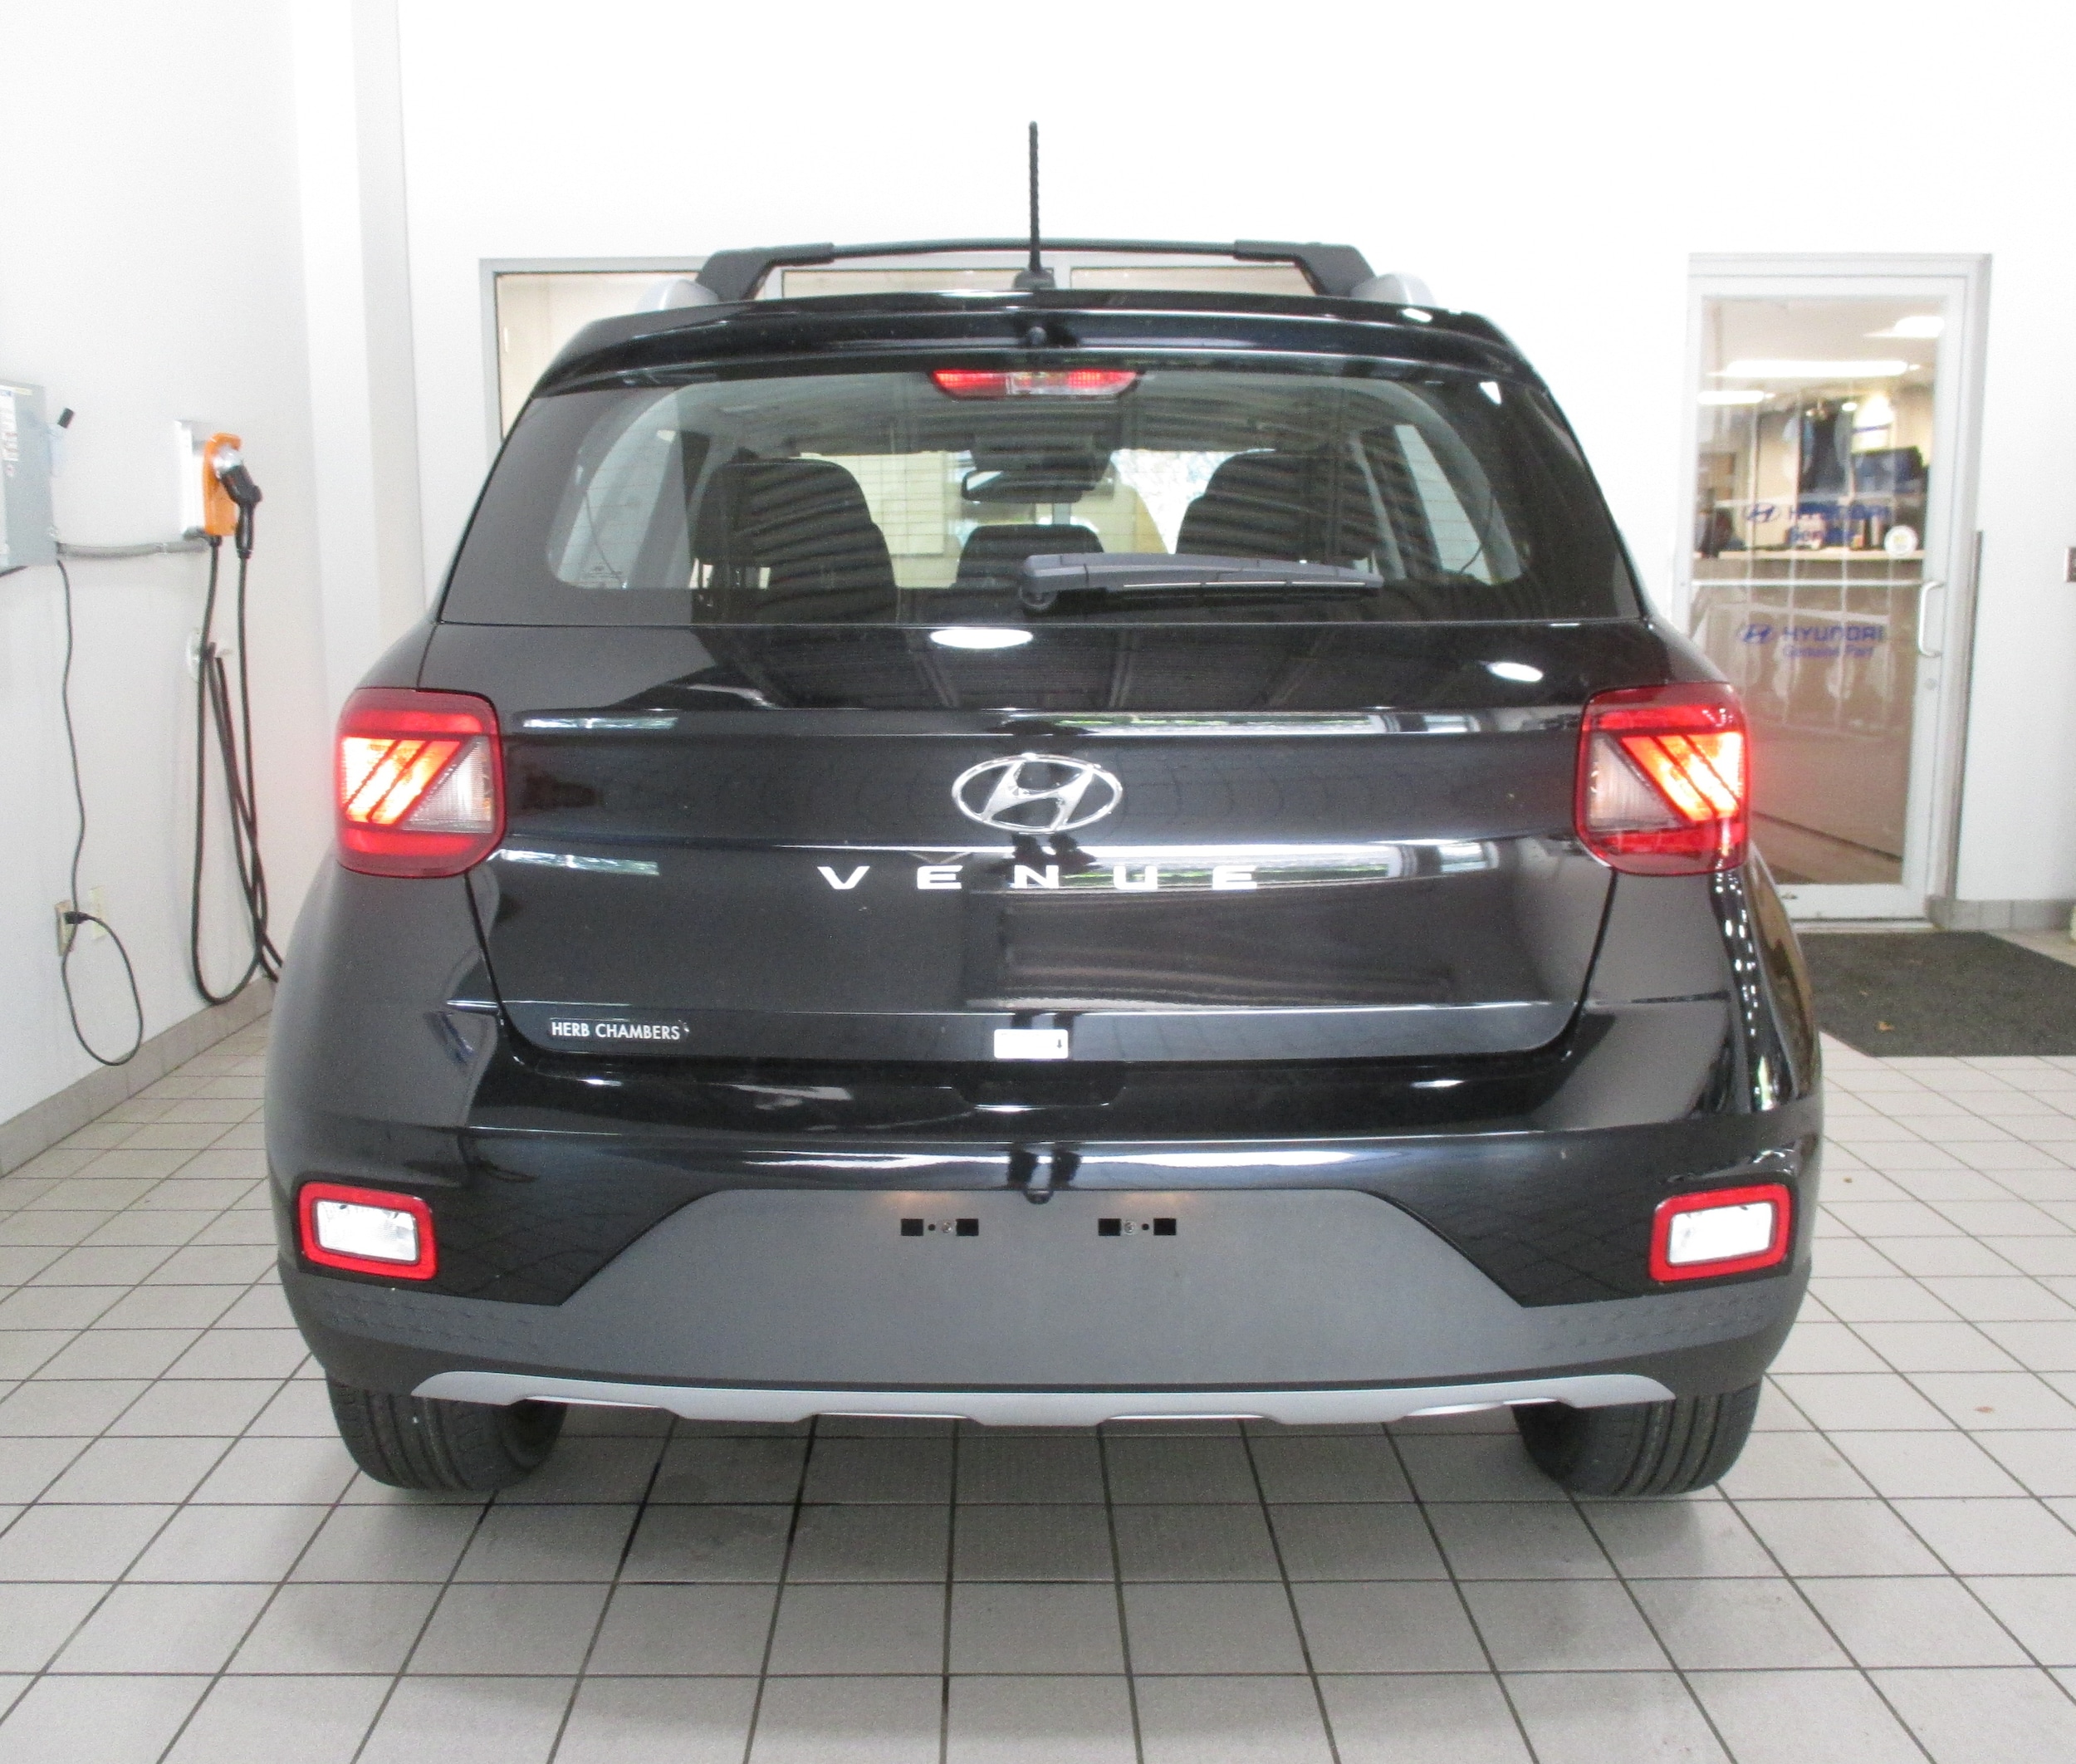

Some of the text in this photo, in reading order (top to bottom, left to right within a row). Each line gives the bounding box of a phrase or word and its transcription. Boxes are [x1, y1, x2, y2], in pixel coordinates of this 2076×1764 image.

[1783, 625, 1885, 643] HYUNDAI
[817, 865, 1258, 890] VENUE
[551, 1022, 681, 1041] HERB CHAMBERS
